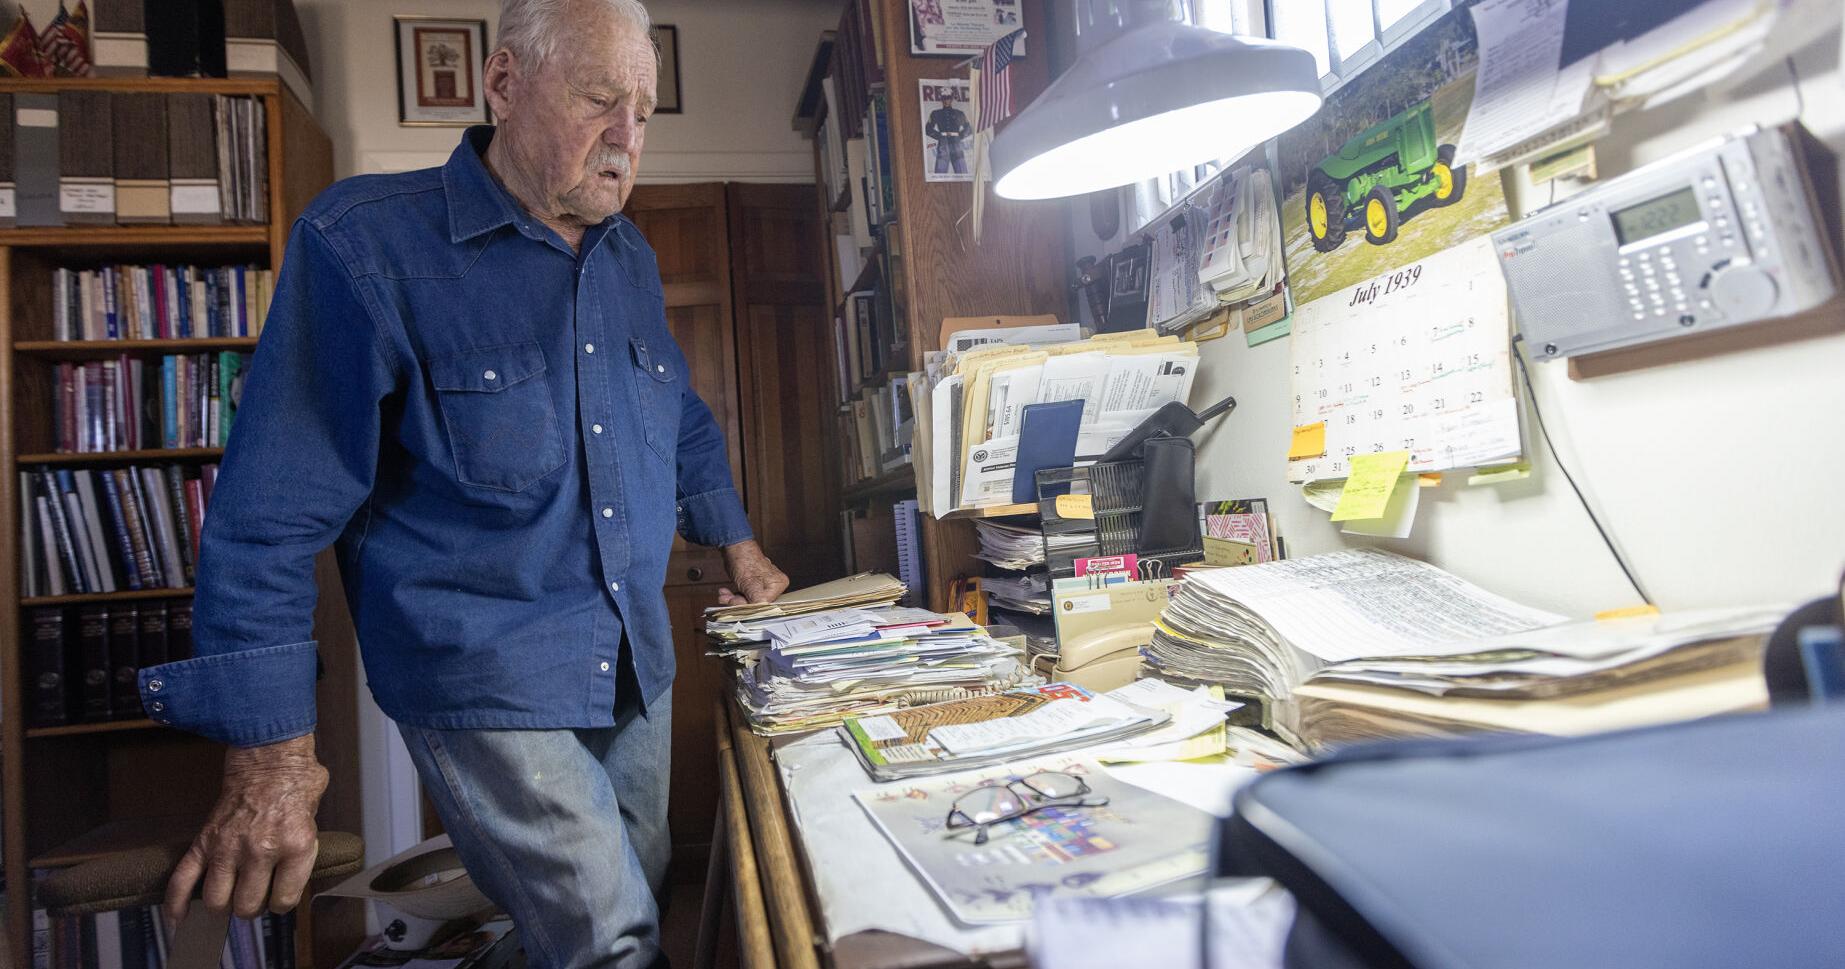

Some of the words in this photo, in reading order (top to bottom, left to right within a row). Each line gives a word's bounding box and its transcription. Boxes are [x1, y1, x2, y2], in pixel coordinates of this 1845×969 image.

[1350, 281, 1381, 307] July
[1383, 264, 1423, 295] 1939
[1295, 365, 1300, 375] 2
[1318, 359, 1324, 368] 3
[1344, 352, 1350, 361] 4
[1371, 344, 1377, 354] 5
[1400, 336, 1406, 346] 6
[1295, 395, 1301, 404] 9
[1318, 389, 1328, 398] 10
[1343, 384, 1353, 393] 11
[1370, 376, 1381, 387] 12
[1400, 370, 1411, 381] 13
[1432, 363, 1443, 374] 14
[1467, 354, 1480, 366] 15
[1346, 415, 1355, 424] 18
[1373, 409, 1383, 420] 19
[1402, 404, 1414, 415] 20
[1435, 399, 1446, 410] 21
[1470, 392, 1483, 403] 22
[1345, 447, 1356, 456] 25
[1373, 442, 1384, 453] 26
[1404, 438, 1415, 449] 27
[1305, 465, 1316, 474] 30
[1332, 462, 1342, 472] 31
